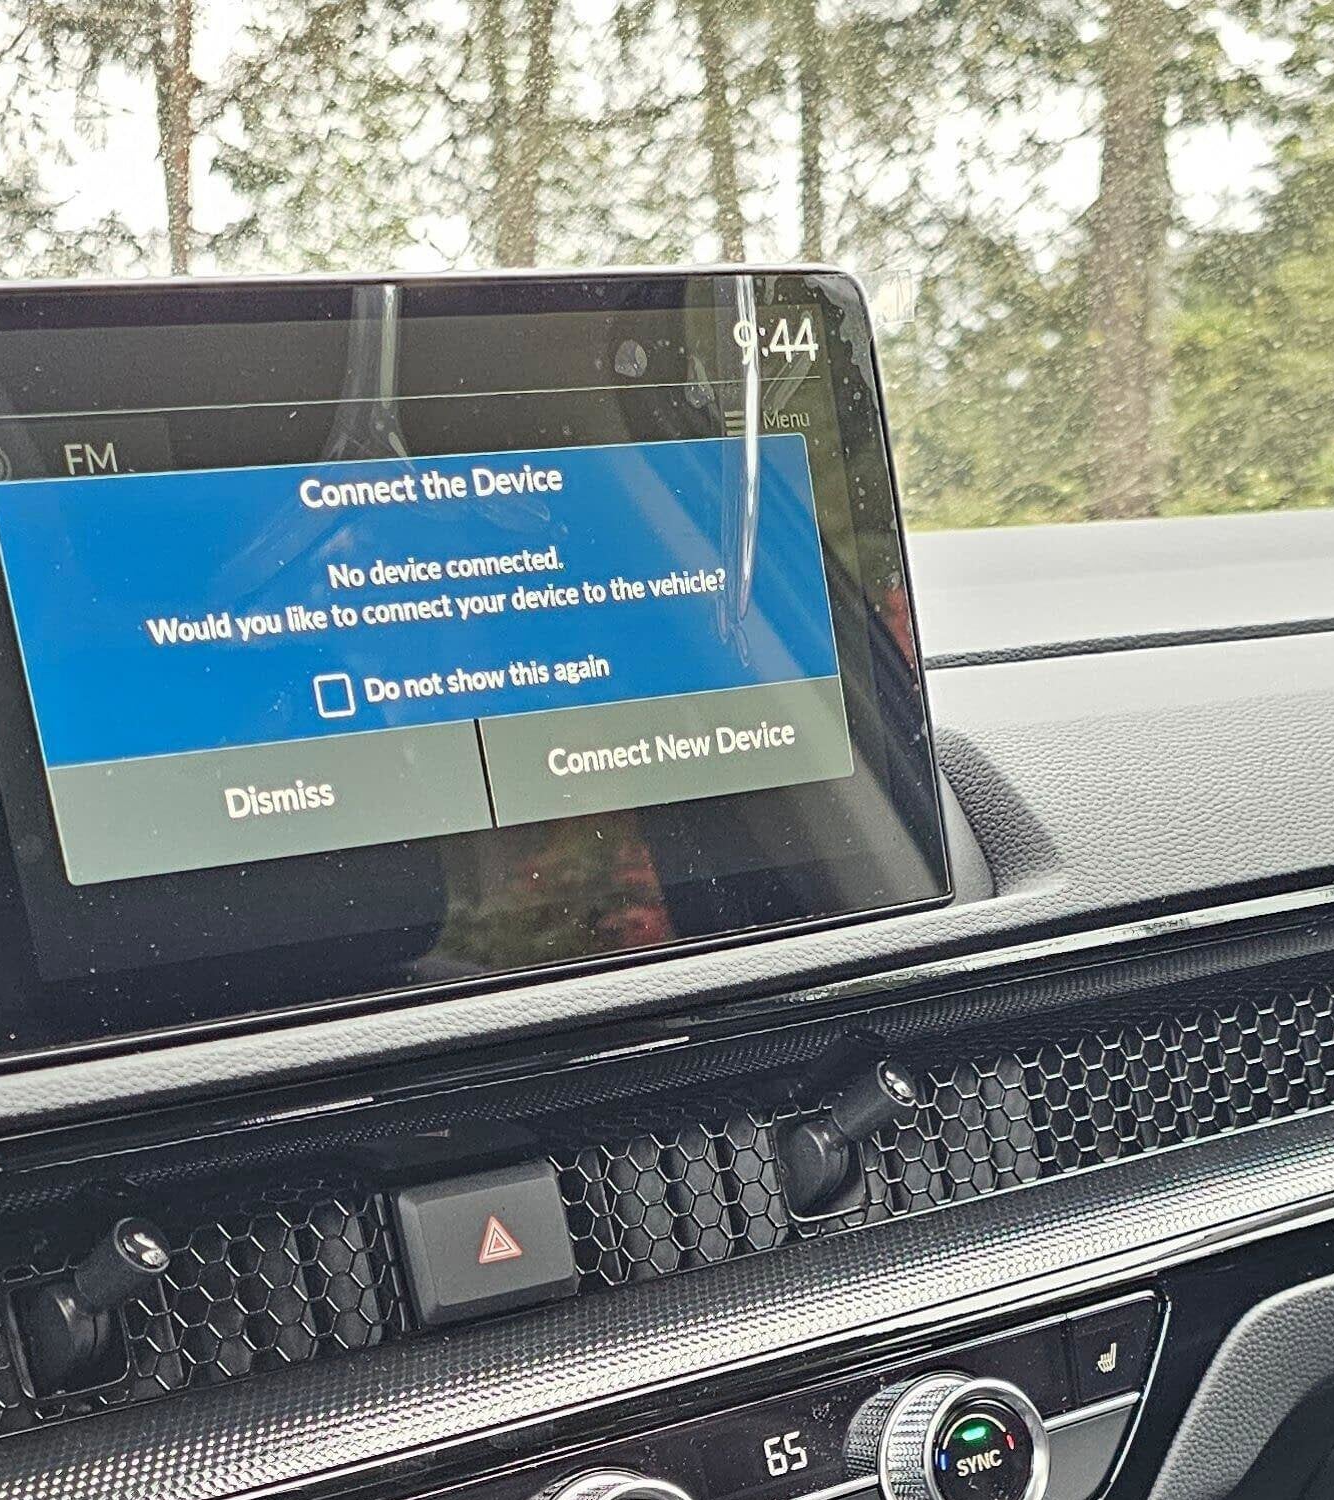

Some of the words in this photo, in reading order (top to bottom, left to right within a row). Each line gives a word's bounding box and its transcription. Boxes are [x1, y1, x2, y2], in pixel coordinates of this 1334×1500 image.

[733, 318, 819, 365] 9:44
[763, 410, 810, 429] Menu
[64, 442, 118, 475] FM
[300, 474, 417, 508] Connect
[420, 471, 467, 500] the
[472, 464, 563, 497] Device
[328, 563, 365, 589] No
[369, 557, 442, 583] device
[446, 546, 564, 579] connected.
[146, 613, 232, 645] Would
[234, 615, 282, 641] you
[285, 605, 328, 633] like
[330, 603, 358, 628] to
[362, 594, 453, 626] connect
[455, 592, 507, 620] your
[511, 583, 580, 611] device
[582, 580, 607, 604] to
[609, 576, 646, 600] the
[648, 568, 726, 596] vehicle?
[364, 677, 401, 702] Do
[405, 671, 444, 697] not
[447, 666, 505, 692] show
[508, 660, 550, 686] this
[554, 653, 610, 684] again
[548, 738, 652, 776] Connect
[655, 734, 710, 762] New
[716, 721, 796, 754] Device
[224, 780, 335, 819] Dismiss
[763, 1431, 808, 1476] 65
[956, 1449, 1003, 1478] SYNC
